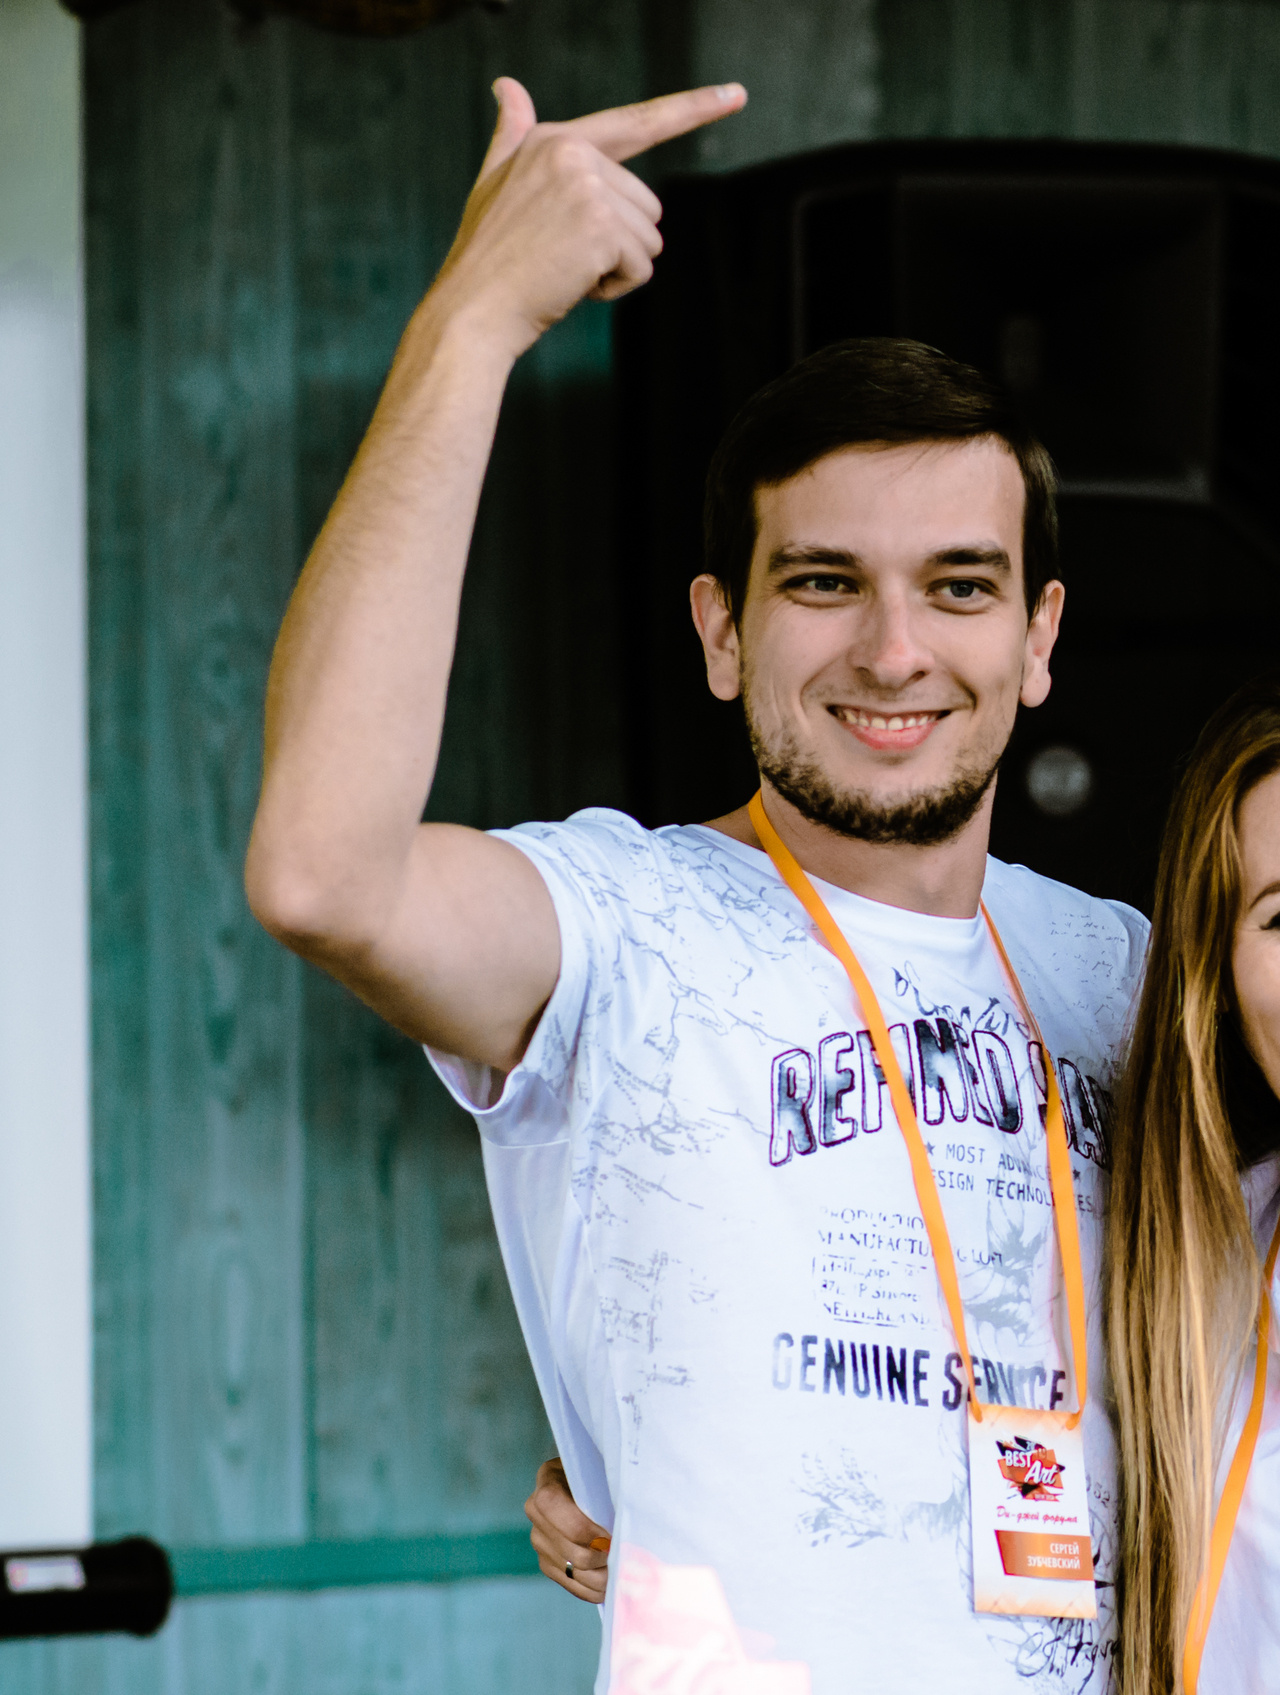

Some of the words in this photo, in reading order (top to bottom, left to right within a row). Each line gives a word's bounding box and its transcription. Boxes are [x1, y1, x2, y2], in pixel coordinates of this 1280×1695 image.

[945, 1143, 985, 1164] MOST
[998, 1153, 1047, 1182] ADVANC
[931, 1169, 974, 1192] SIGN
[986, 1178, 1093, 1212] TECHNOLES
[771, 1332, 931, 1407] GENUINE
[942, 1352, 1066, 1412] SERVICE
[1005, 1450, 1036, 1468] BEST
[1024, 1460, 1058, 1485] Art
[1050, 1542, 1079, 1555] СЕРГЕЙ
[1027, 1555, 1080, 1570] ЗУБЧЕВСКИЙ
